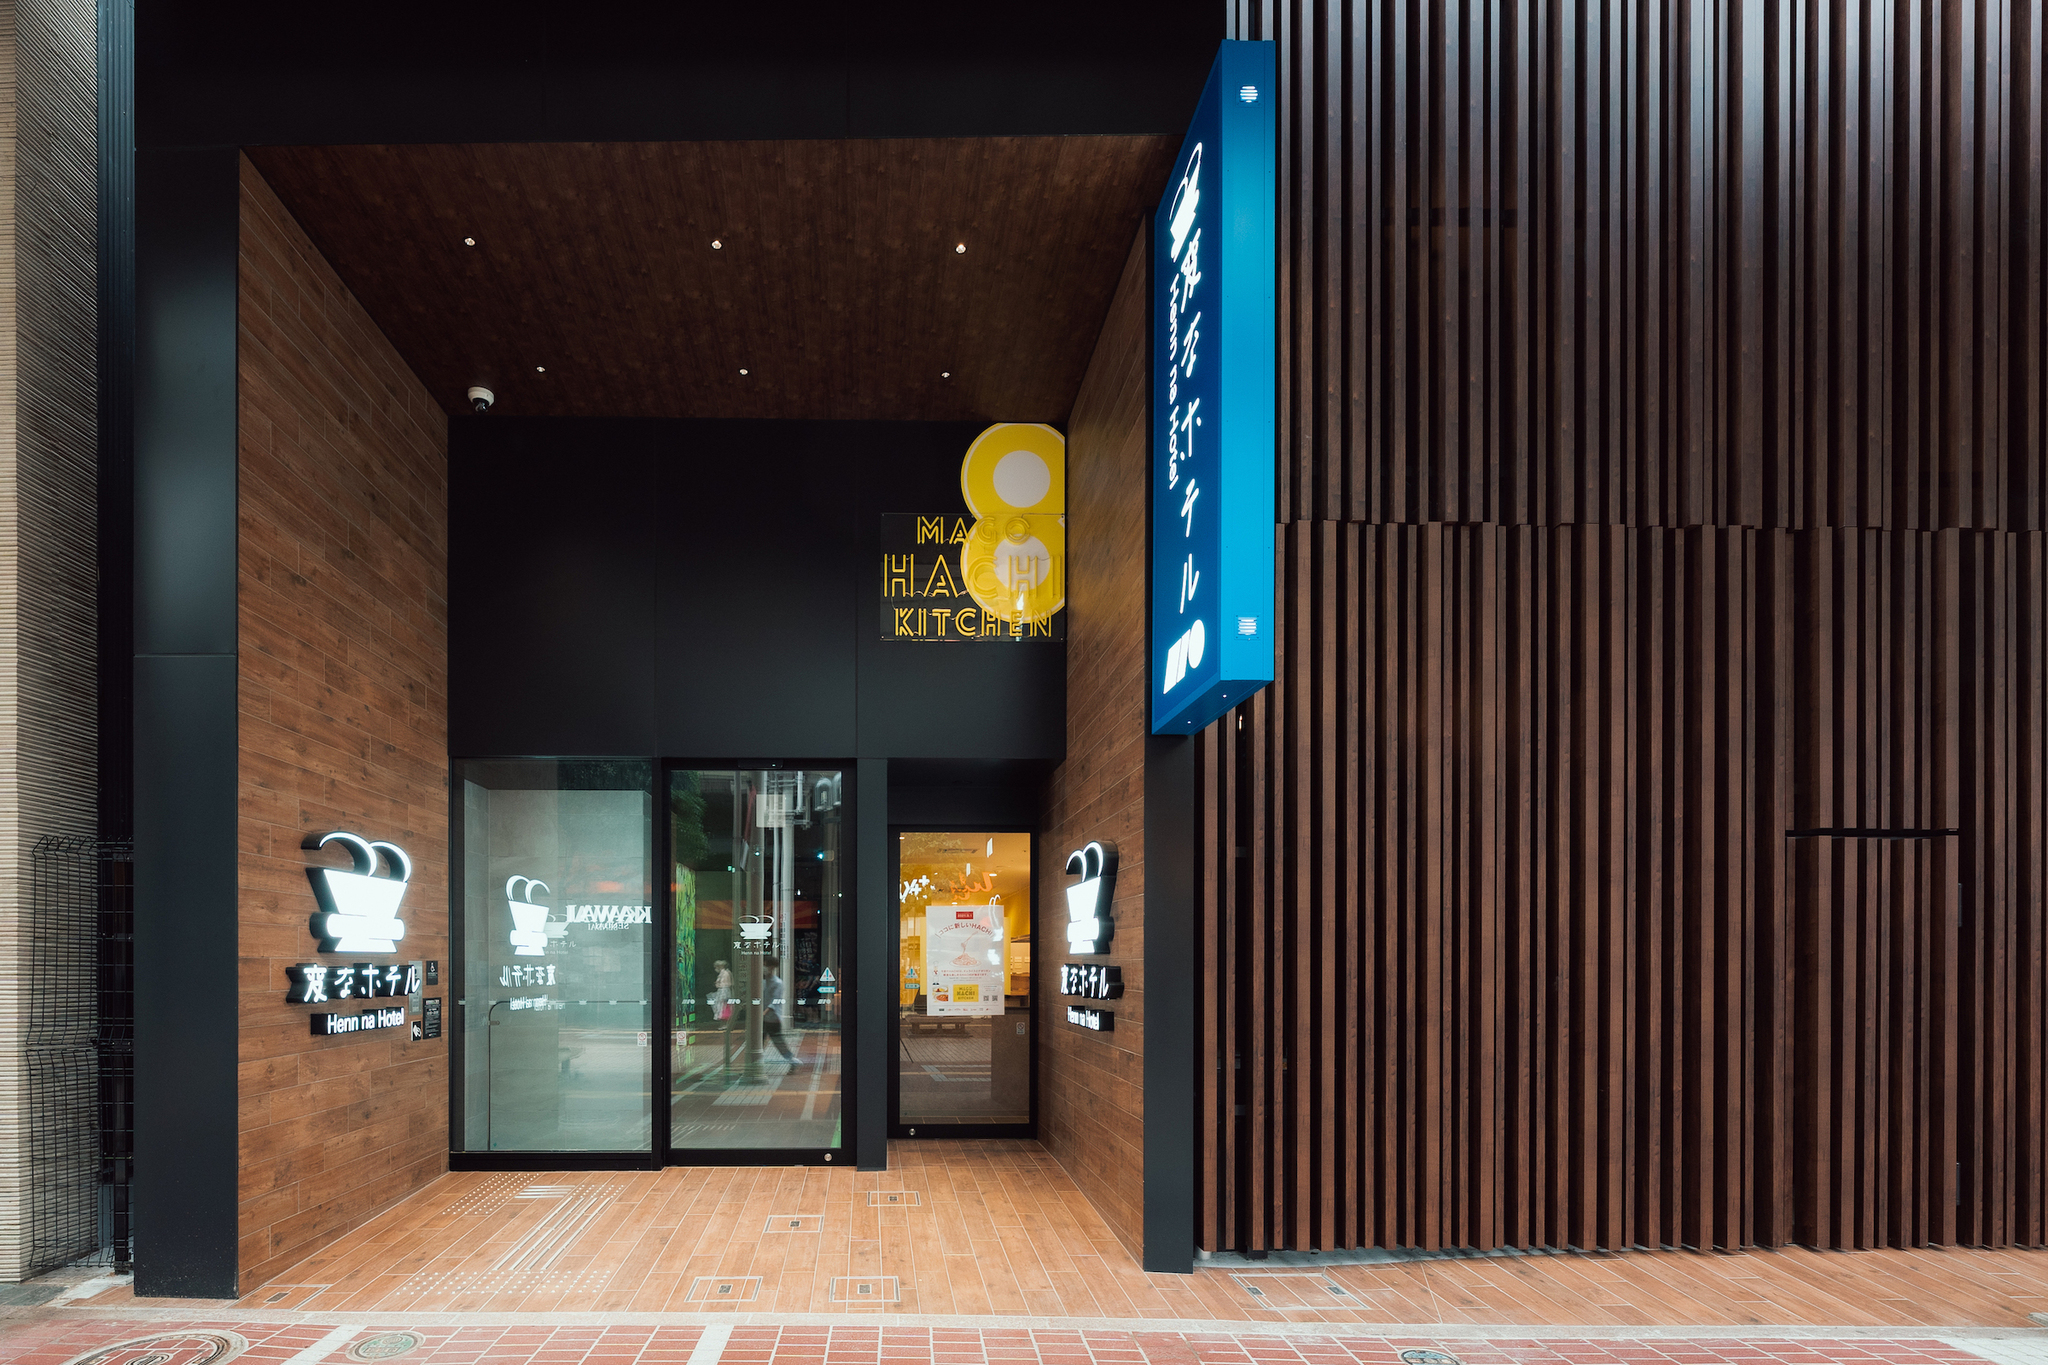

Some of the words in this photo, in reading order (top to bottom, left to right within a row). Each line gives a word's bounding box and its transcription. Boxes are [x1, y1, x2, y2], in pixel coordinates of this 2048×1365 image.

[1169, 273, 1180, 361] Henn
[1169, 364, 1178, 405] na
[1179, 228, 1201, 614] 変なホテル
[1169, 405, 1179, 490] Hotel
[917, 516, 1031, 546] MAGO
[884, 553, 1062, 599] HACHI
[895, 607, 1052, 638] KITCHEN
[303, 964, 420, 1002] 変なホテル
[1060, 964, 1109, 999] 変なホテル
[327, 1013, 359, 1034] Henn
[361, 1014, 375, 1030] na
[377, 1007, 405, 1028] Hotel
